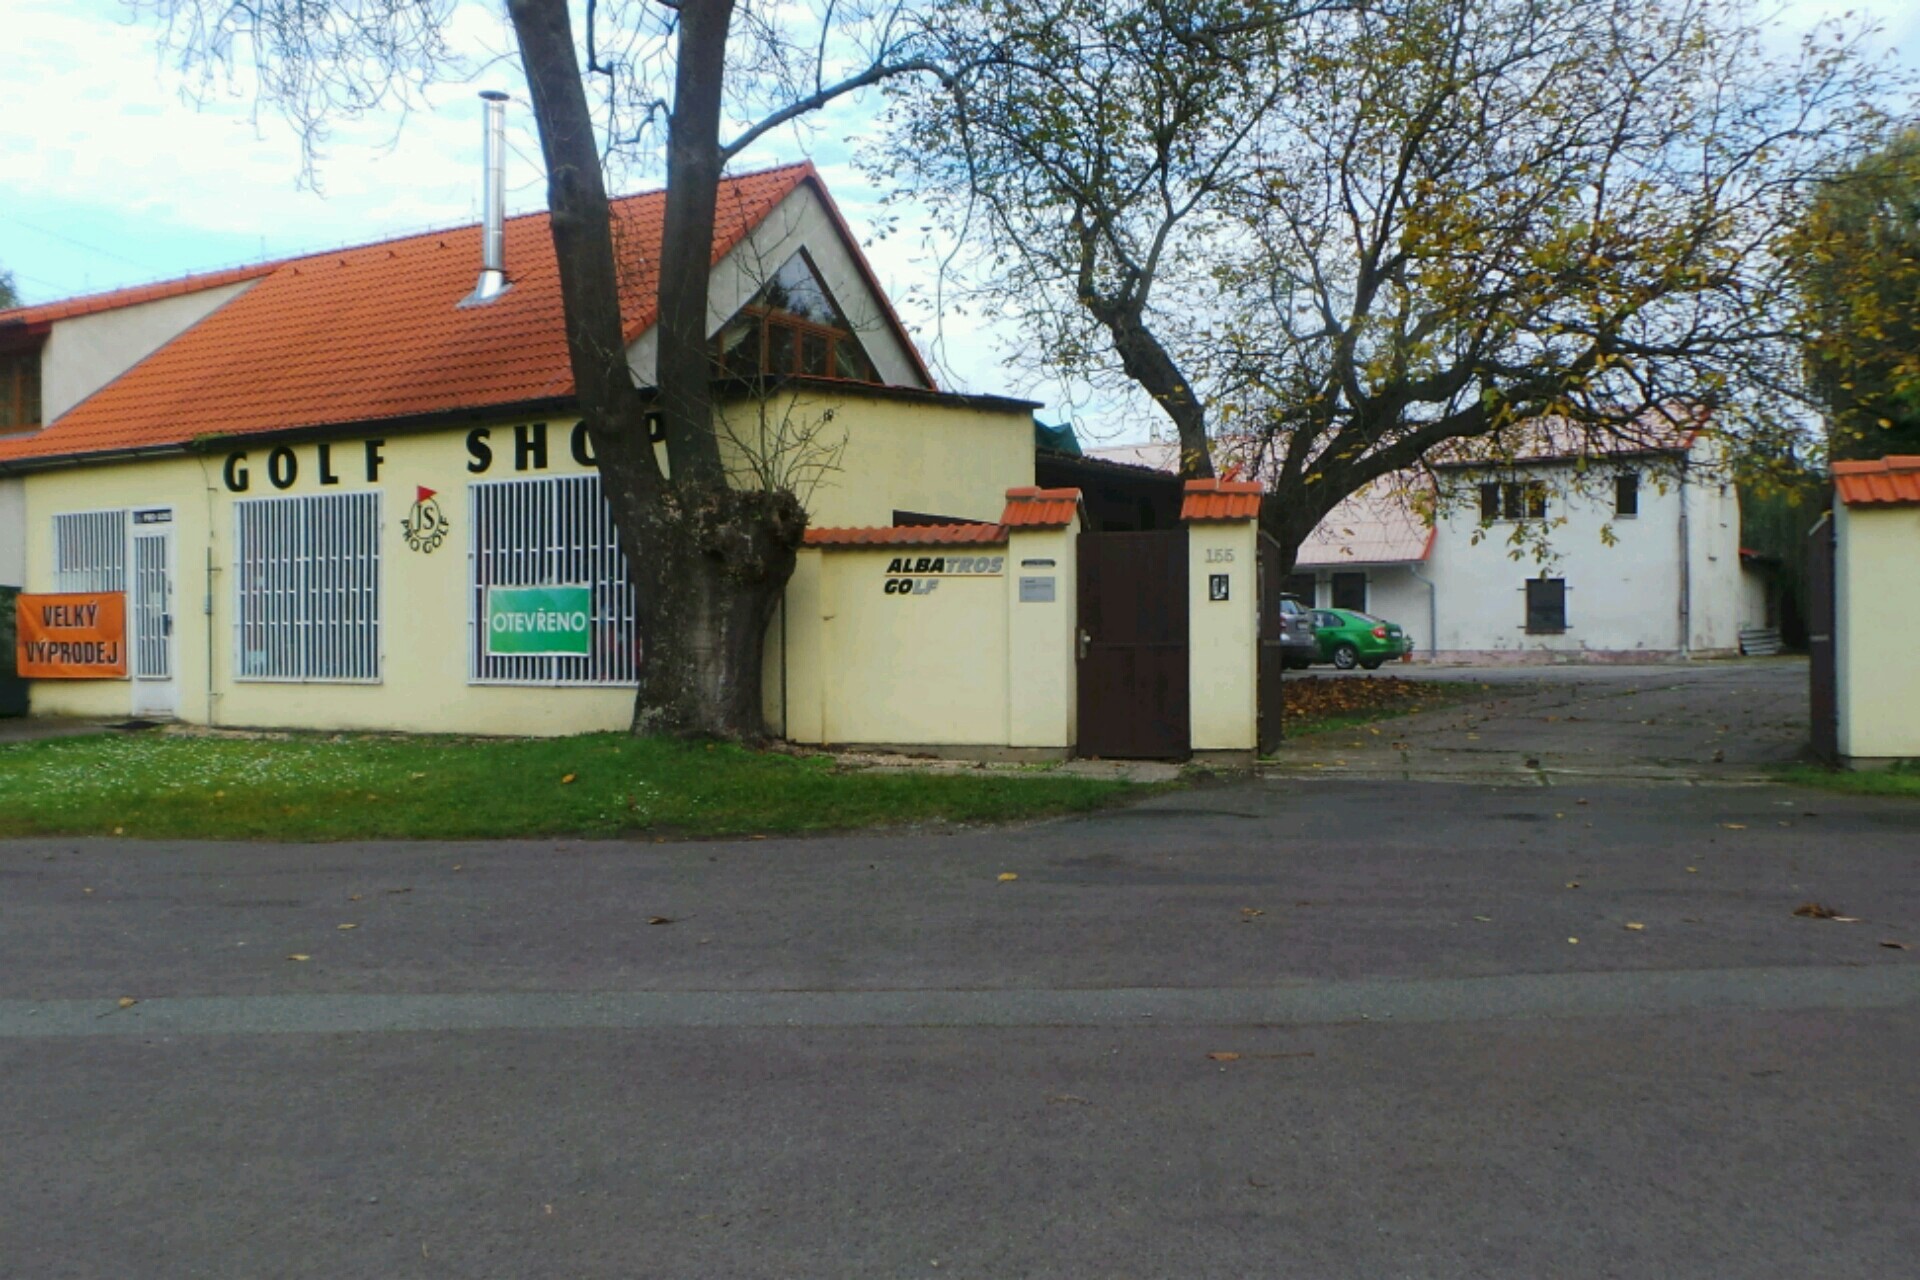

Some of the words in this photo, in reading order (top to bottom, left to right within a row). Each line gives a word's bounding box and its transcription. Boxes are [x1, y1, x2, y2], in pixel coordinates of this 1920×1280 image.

[223, 439, 385, 493] GOLF
[414, 503, 436, 533] JS
[422, 515, 450, 554] GOLF
[886, 556, 1004, 574] ALBATROS
[1205, 548, 1235, 563] 155
[884, 578, 939, 595] GOLF
[42, 600, 98, 629] VELKÝ
[492, 607, 587, 633] OTEVŘENO
[25, 637, 119, 666] VÝPRODEJ
